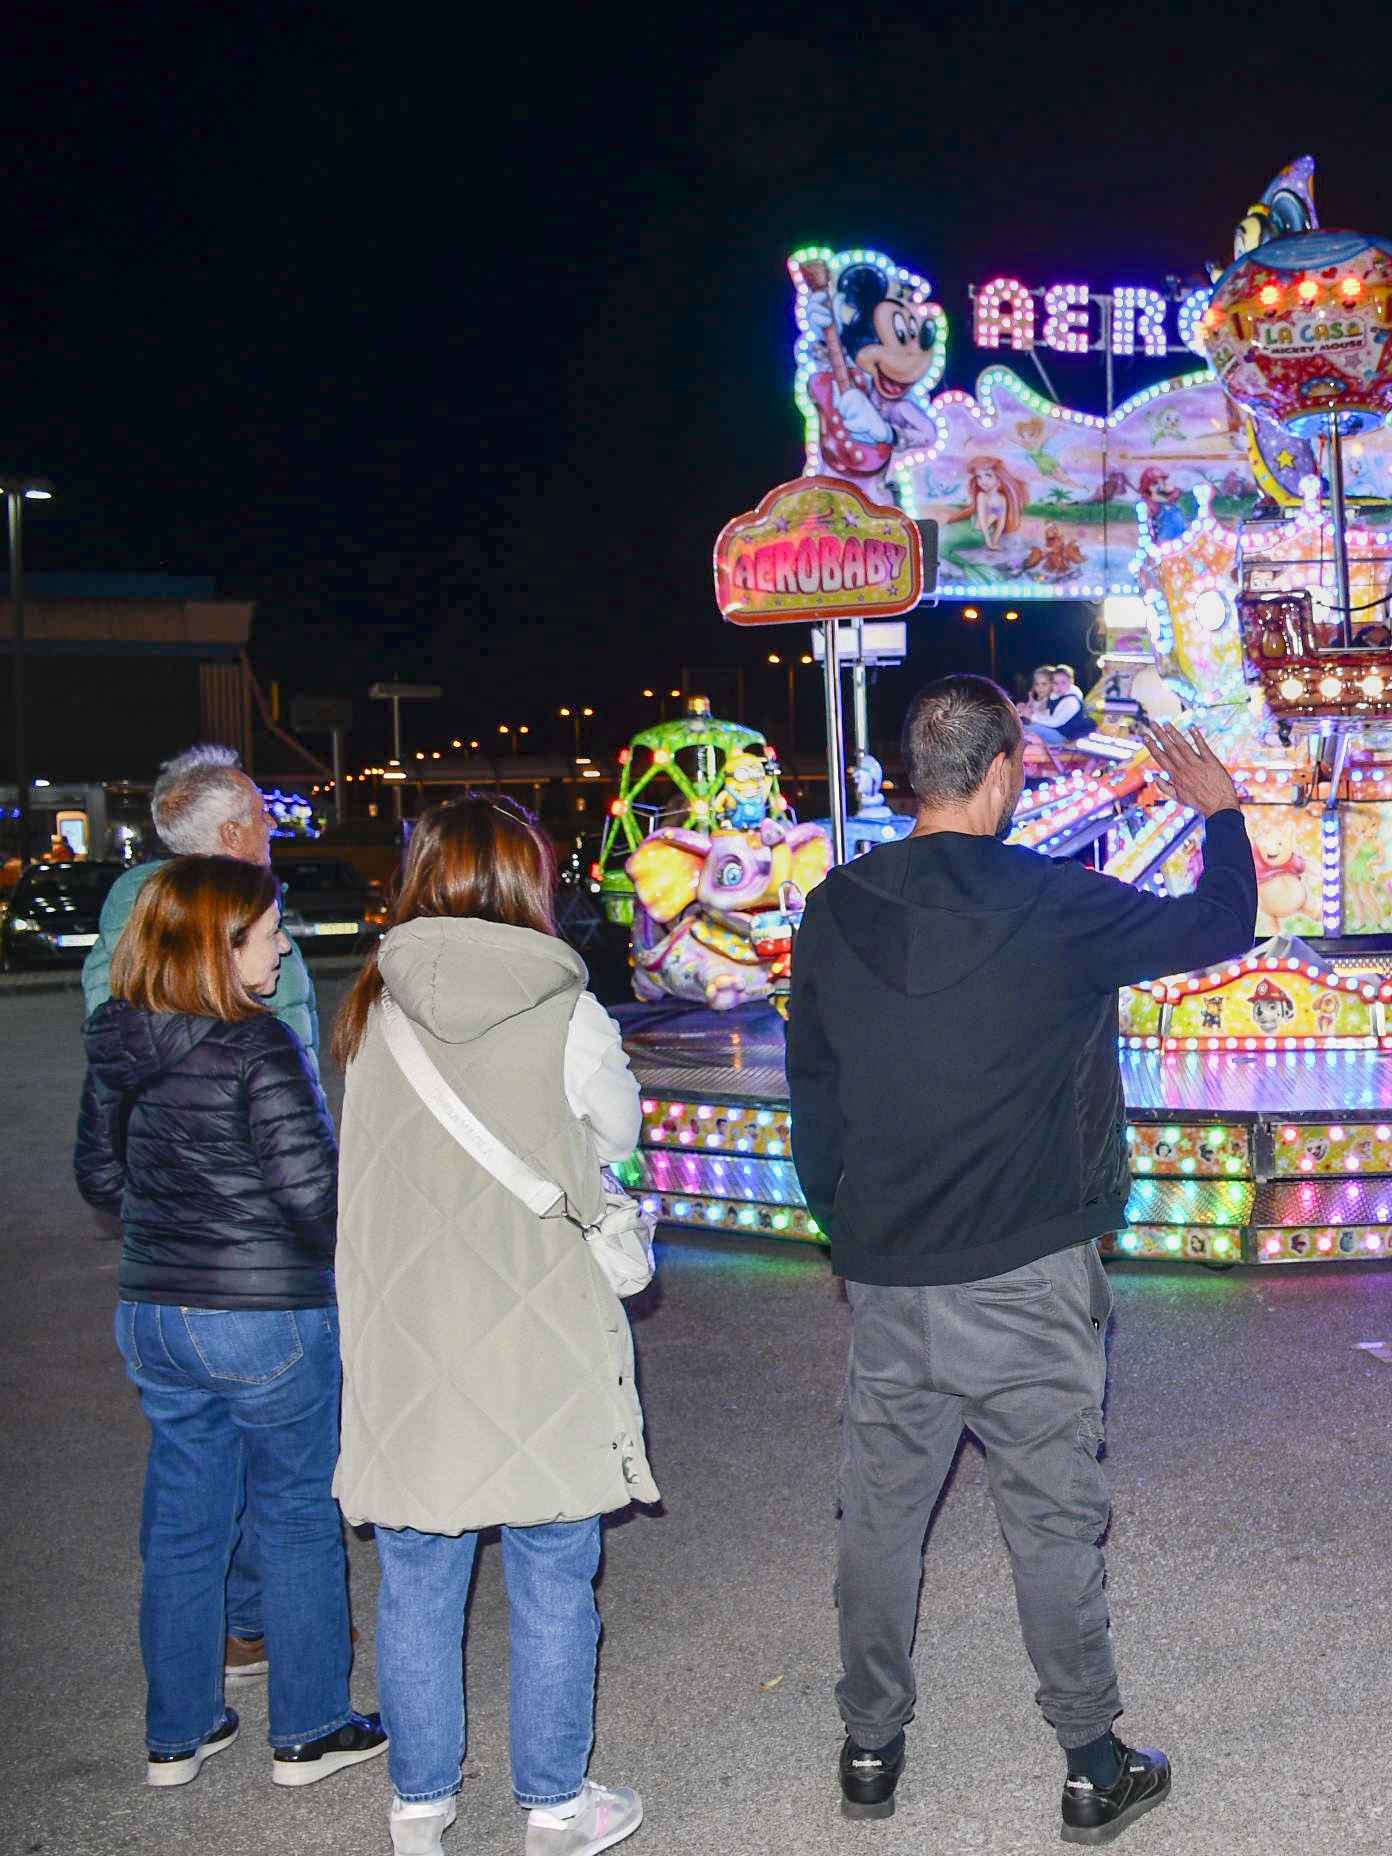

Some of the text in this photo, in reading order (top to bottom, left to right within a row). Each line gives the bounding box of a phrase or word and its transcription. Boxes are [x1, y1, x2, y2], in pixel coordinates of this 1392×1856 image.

[1265, 326, 1293, 345] LA
[734, 536, 907, 596] AEROBABY
[852, 1759, 883, 1768] Reebok
